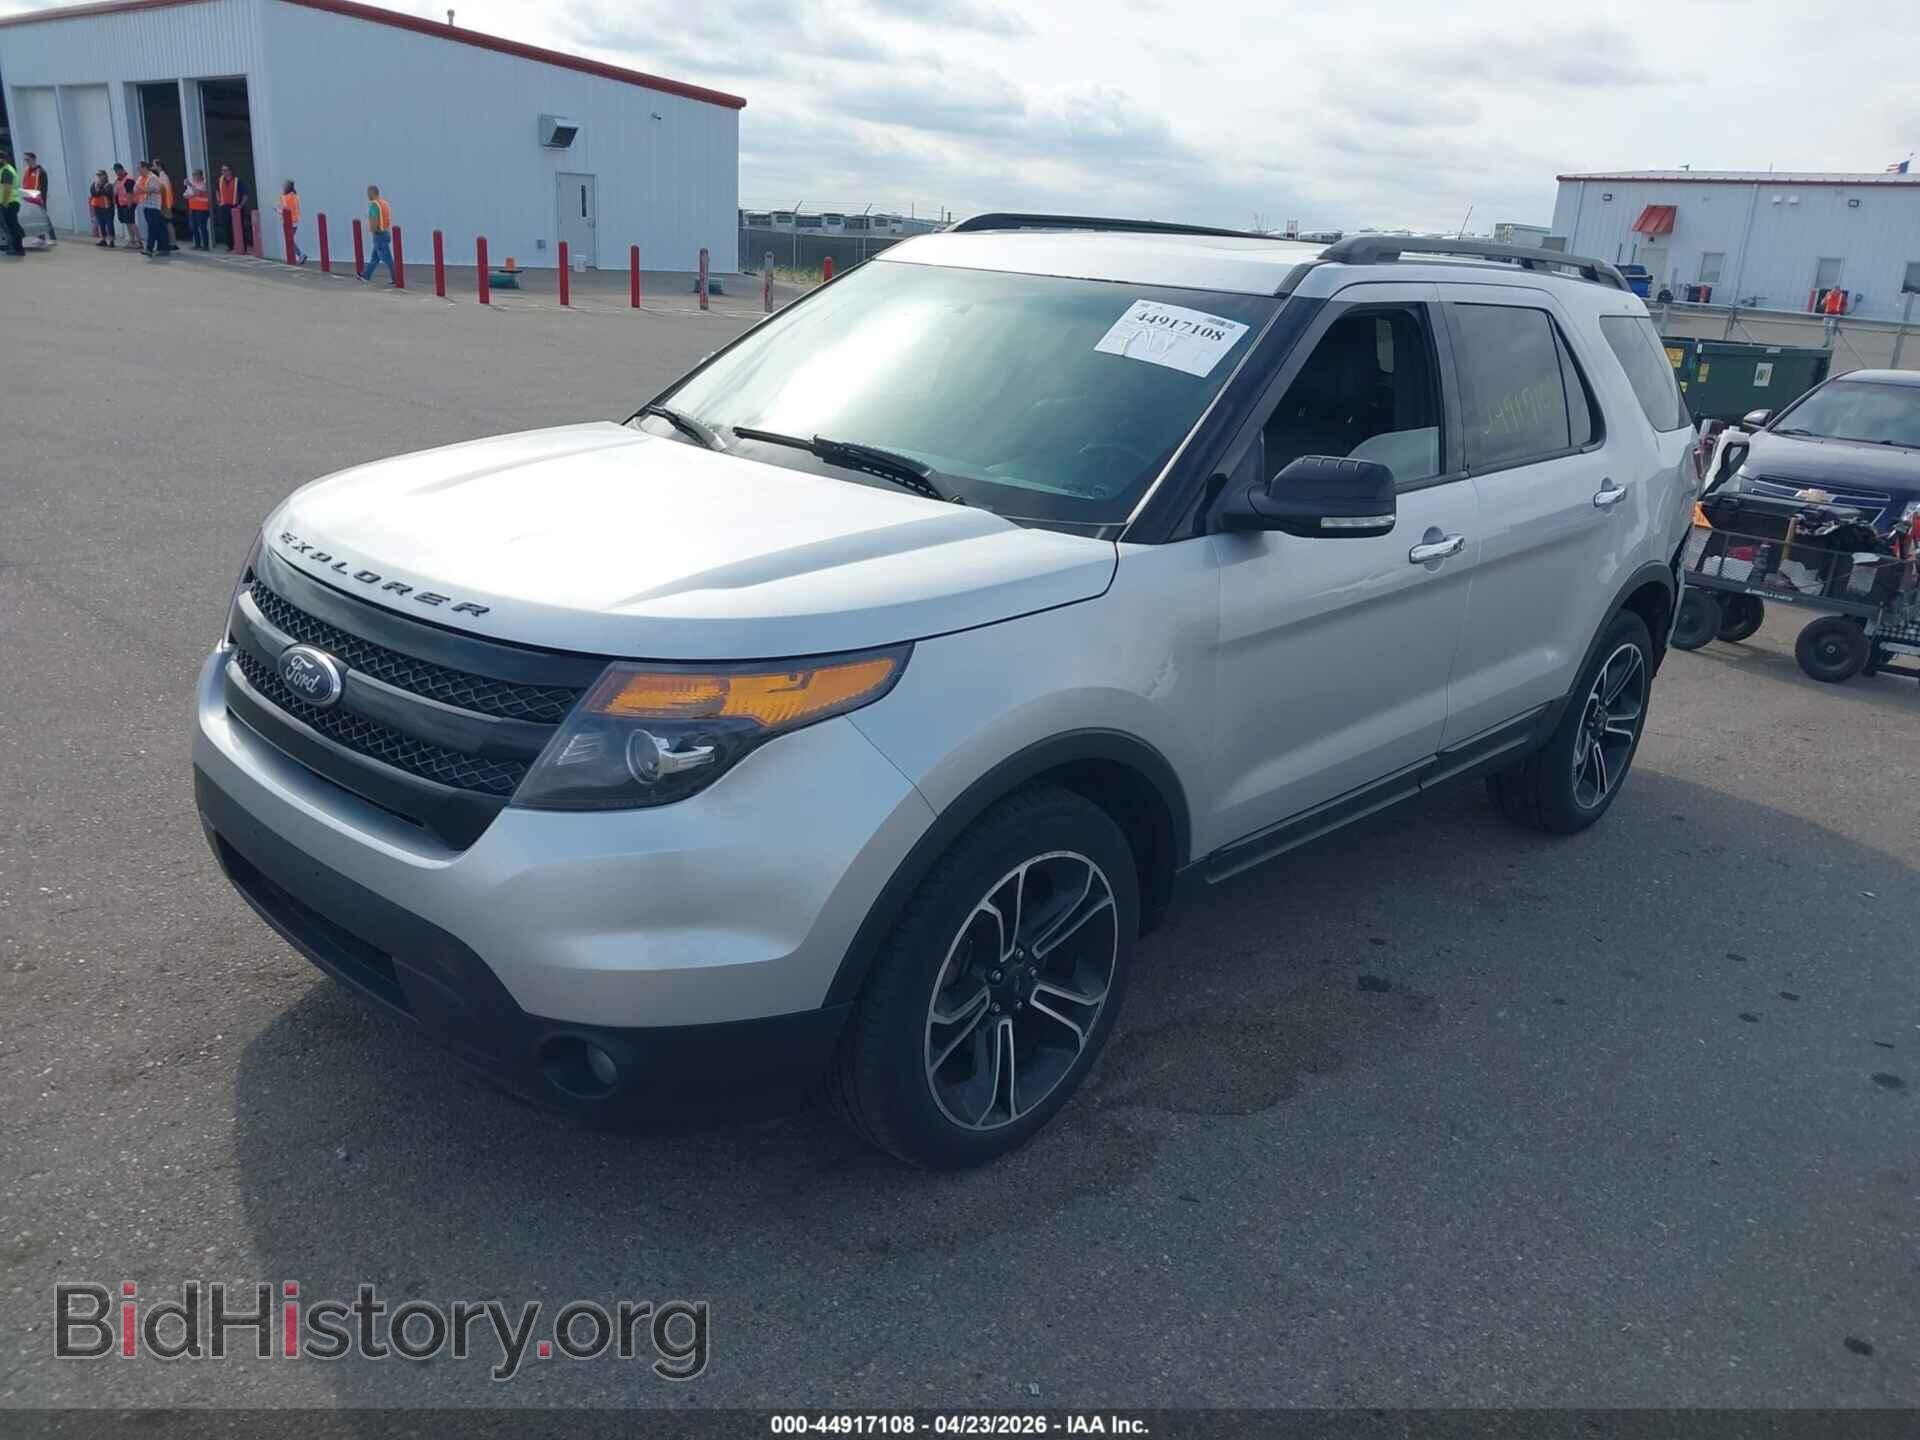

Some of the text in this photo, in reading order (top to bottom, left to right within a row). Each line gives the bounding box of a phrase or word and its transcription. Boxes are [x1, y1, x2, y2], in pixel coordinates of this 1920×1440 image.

[1137, 312, 1225, 341] 44917108
[280, 532, 491, 617] EXPLORER
[285, 655, 320, 694] Ford
